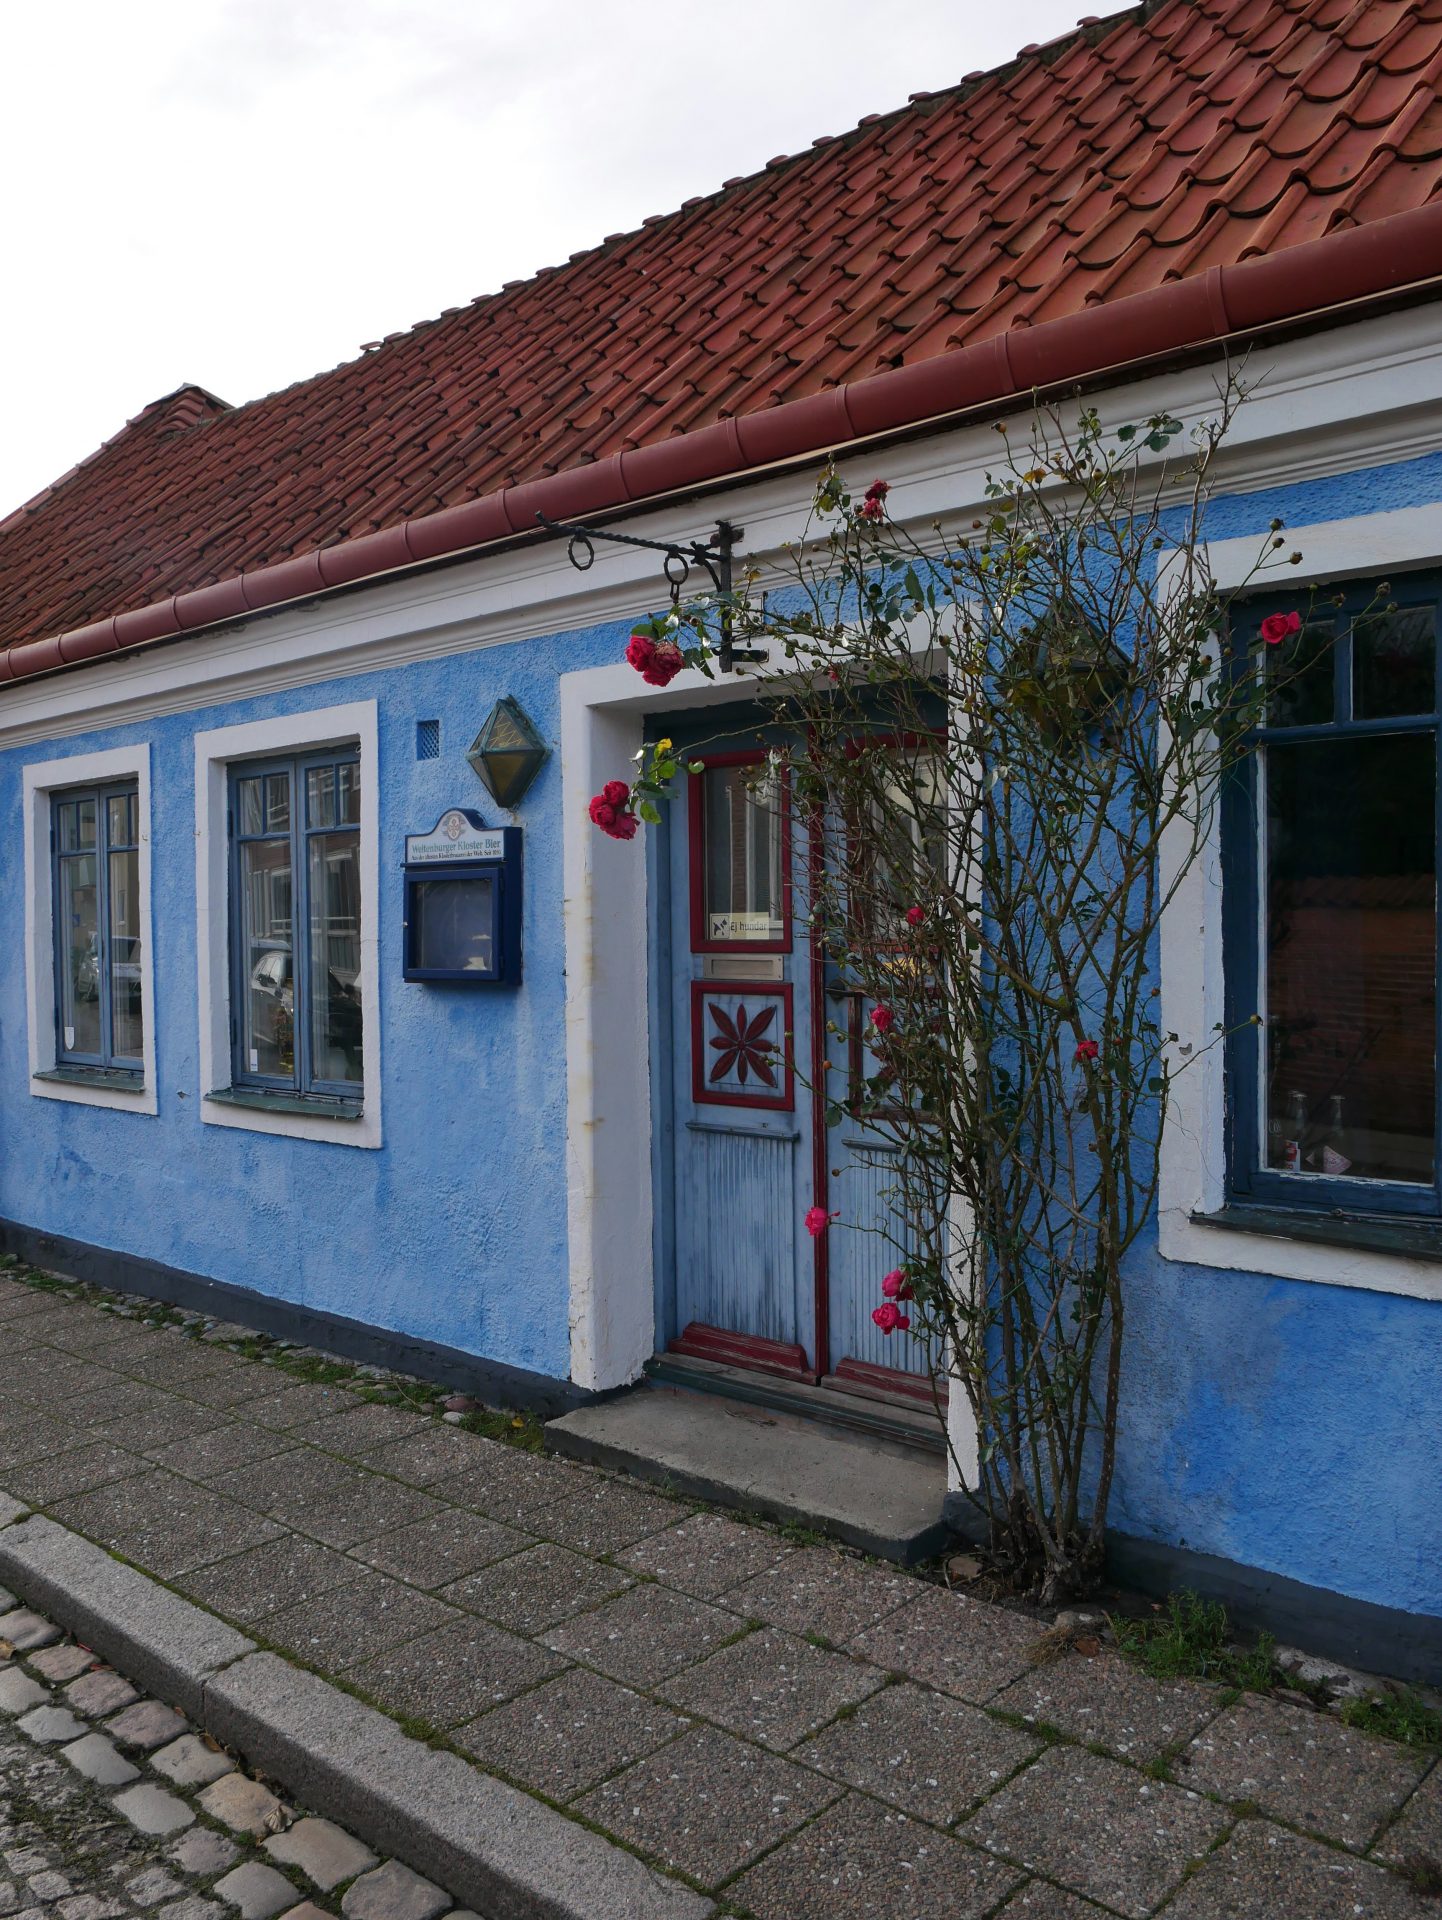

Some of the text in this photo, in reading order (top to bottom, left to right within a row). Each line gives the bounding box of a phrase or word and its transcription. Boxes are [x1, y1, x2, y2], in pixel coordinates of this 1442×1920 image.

[412, 838, 501, 854] Weltenburger Kloster Bier
[731, 921, 767, 933] Ej hundar
